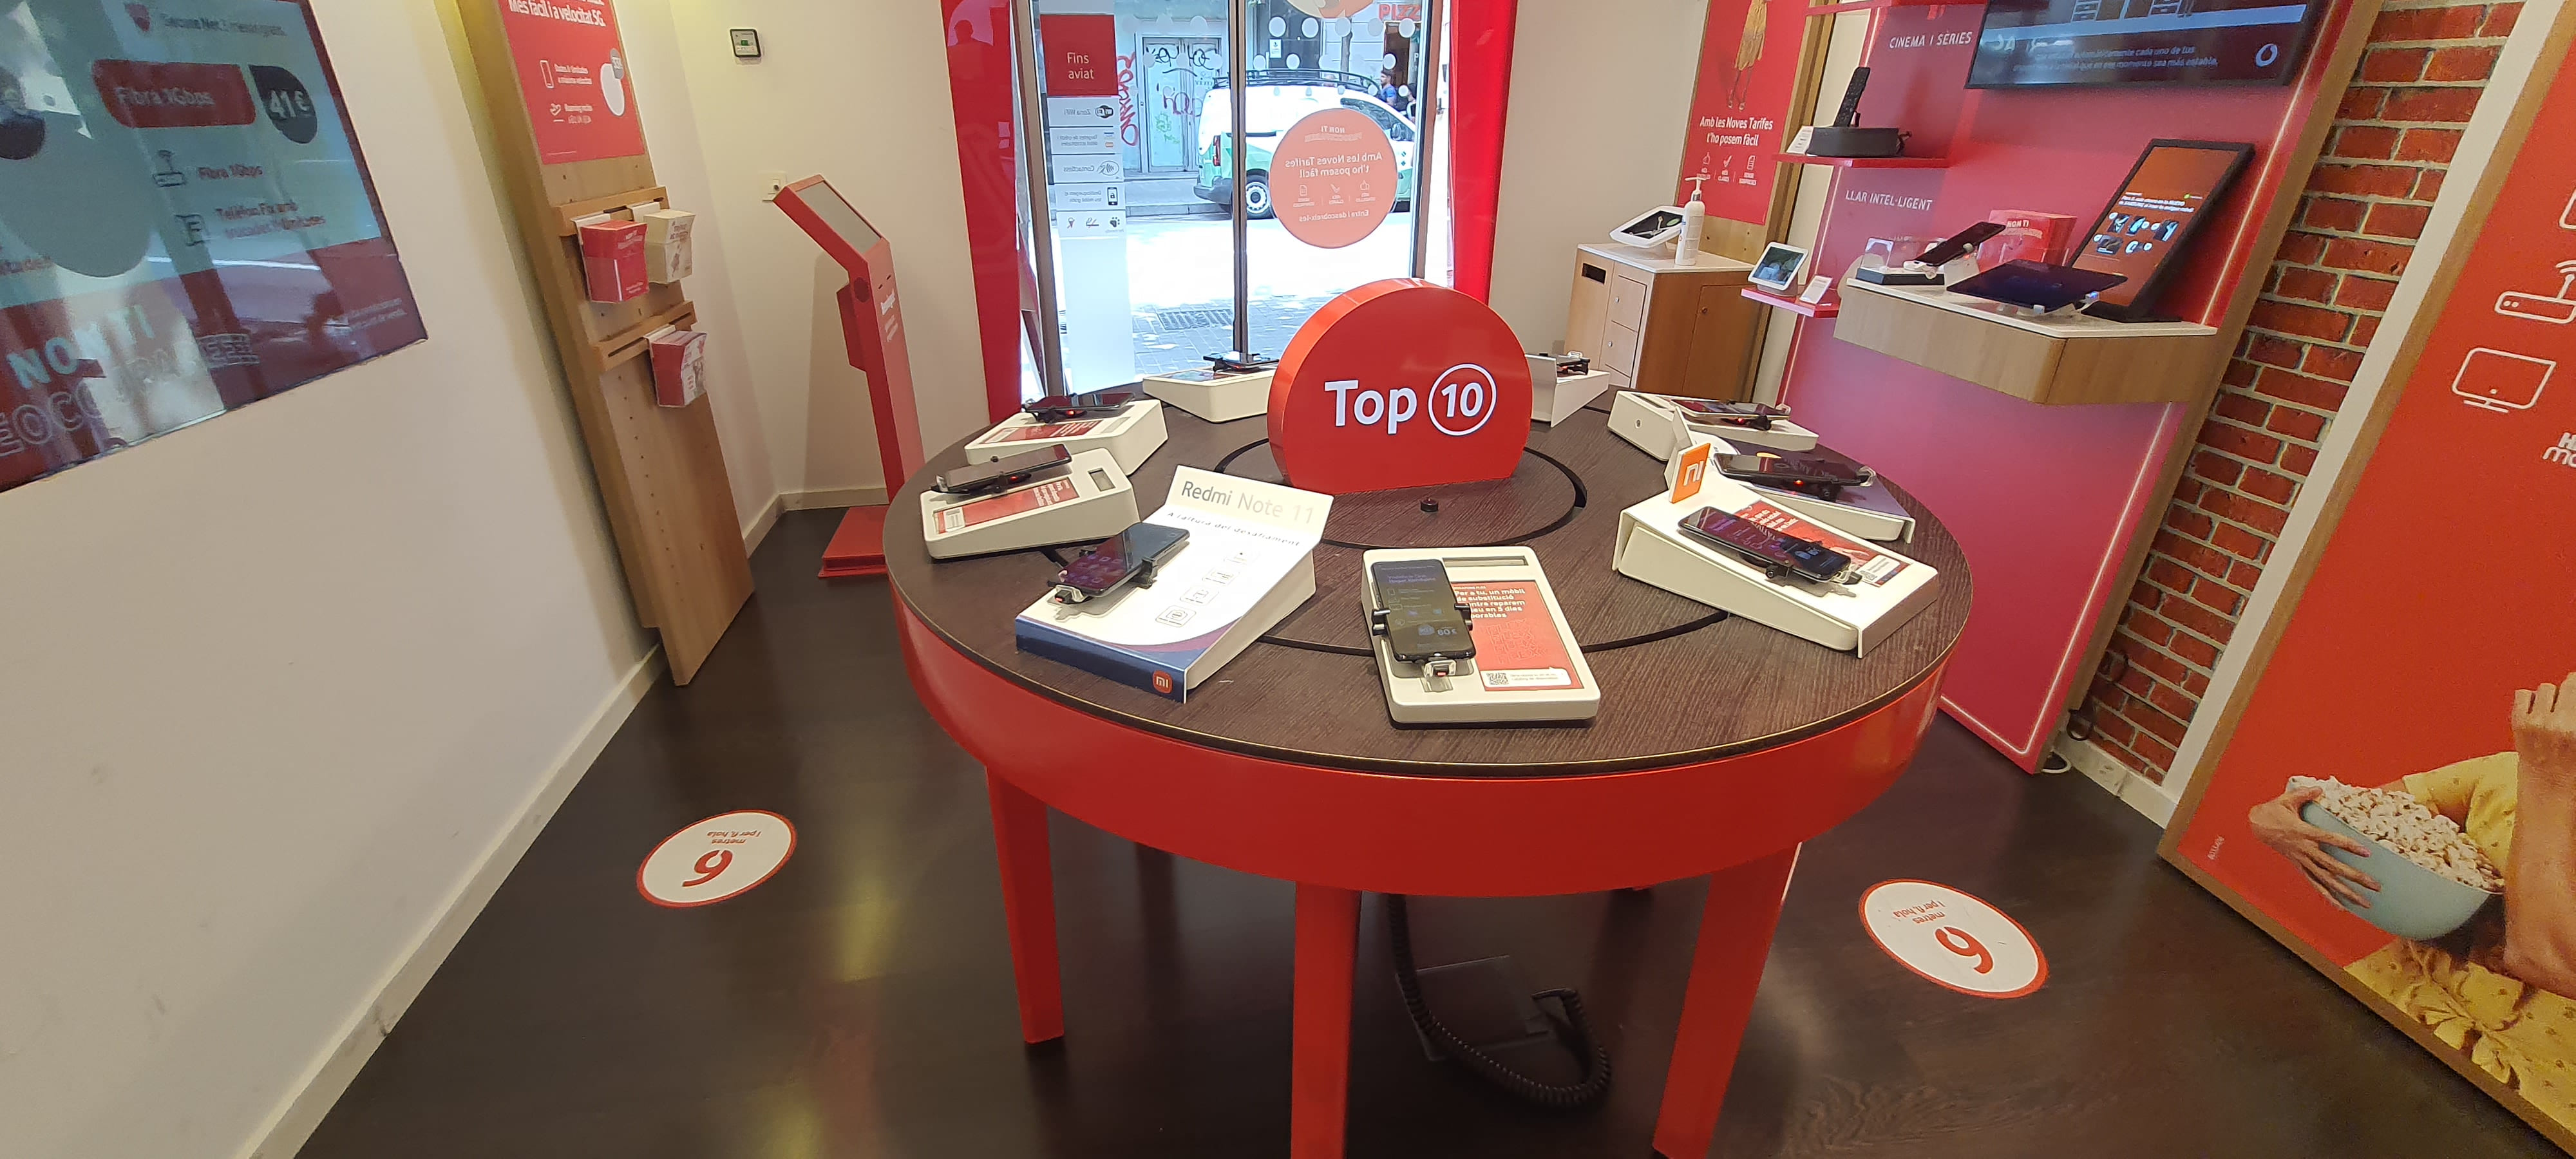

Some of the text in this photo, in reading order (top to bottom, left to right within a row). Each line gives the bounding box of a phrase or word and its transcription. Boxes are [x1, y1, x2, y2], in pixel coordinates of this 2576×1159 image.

[1889, 35, 1925, 49] CINEMA
[1937, 30, 1973, 46] SÈRIES
[1067, 52, 1089, 64] Fins
[1068, 68, 1094, 80] aviat
[1700, 116, 1773, 130] Amb les Noves Tarifes
[1719, 135, 1743, 146] posem
[1845, 189, 1867, 203] LLAR
[1324, 379, 1483, 435] Top 10
[1181, 480, 1315, 524] Redmi Note 11
[1893, 908, 1918, 918] hola
[1912, 911, 1946, 924] metres
